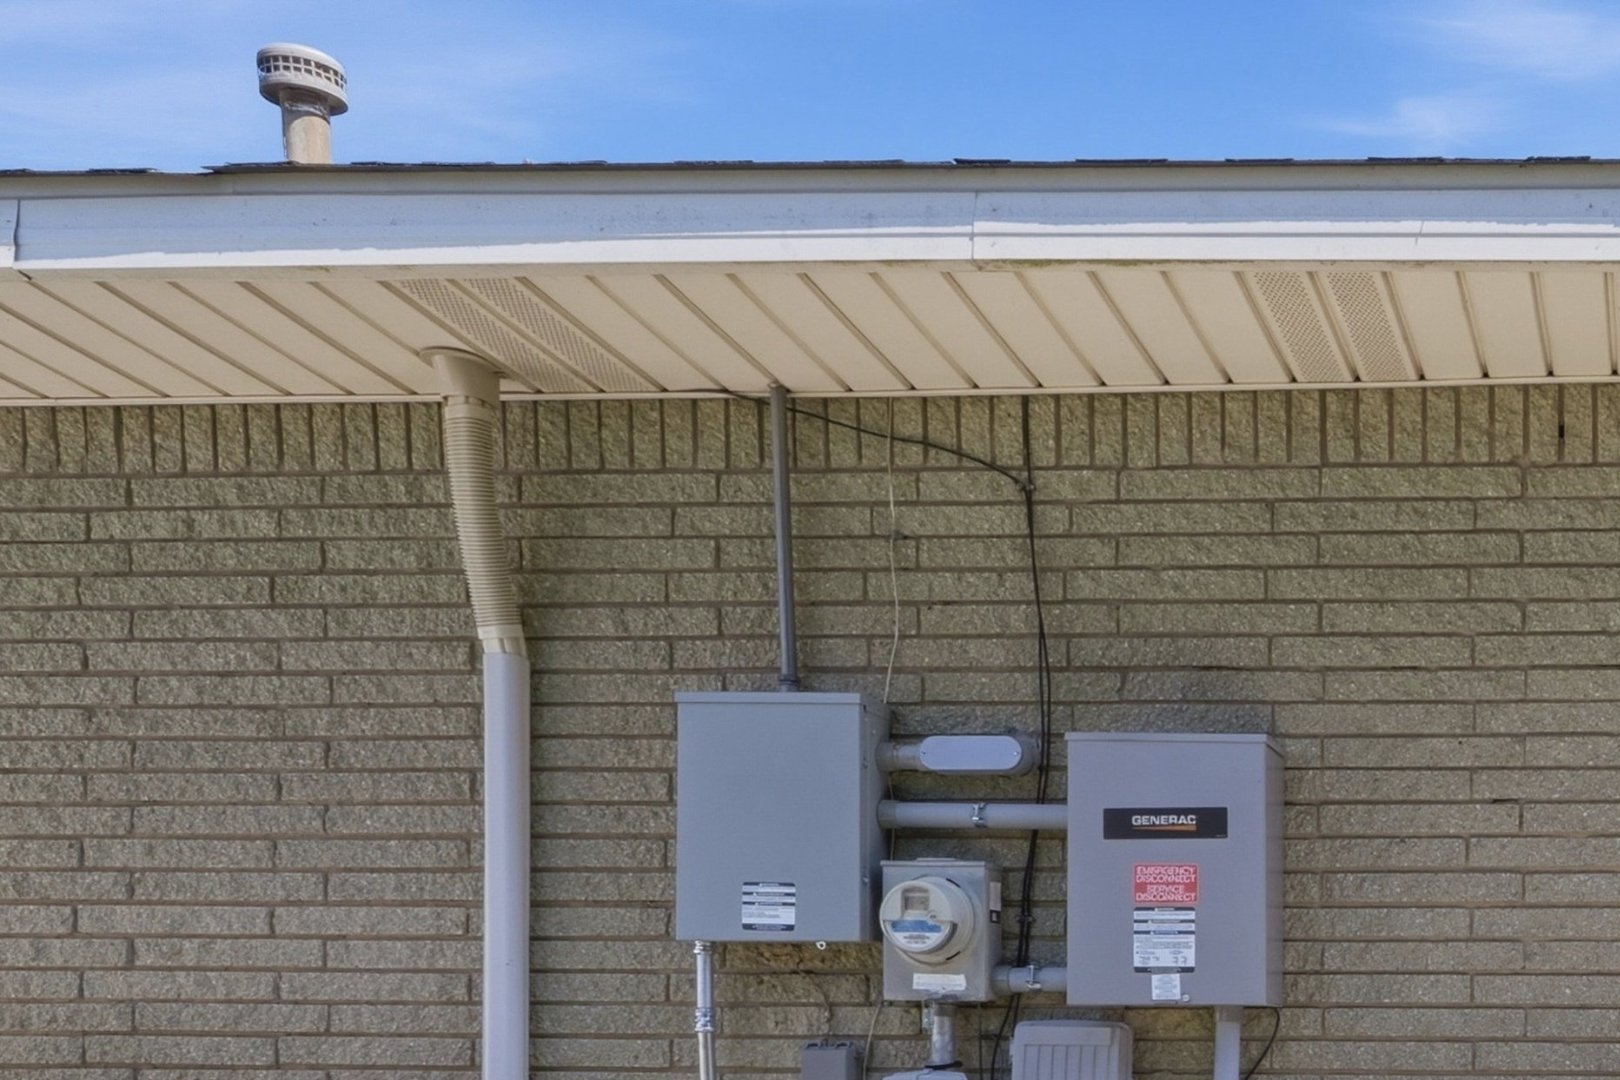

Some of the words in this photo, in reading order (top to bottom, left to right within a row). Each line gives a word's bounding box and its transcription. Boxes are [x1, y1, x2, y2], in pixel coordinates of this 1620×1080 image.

[1131, 815, 1197, 826] GENERAC
[1136, 875, 1196, 883] DISCONNECT
[1136, 893, 1196, 901] DISCONNECT
